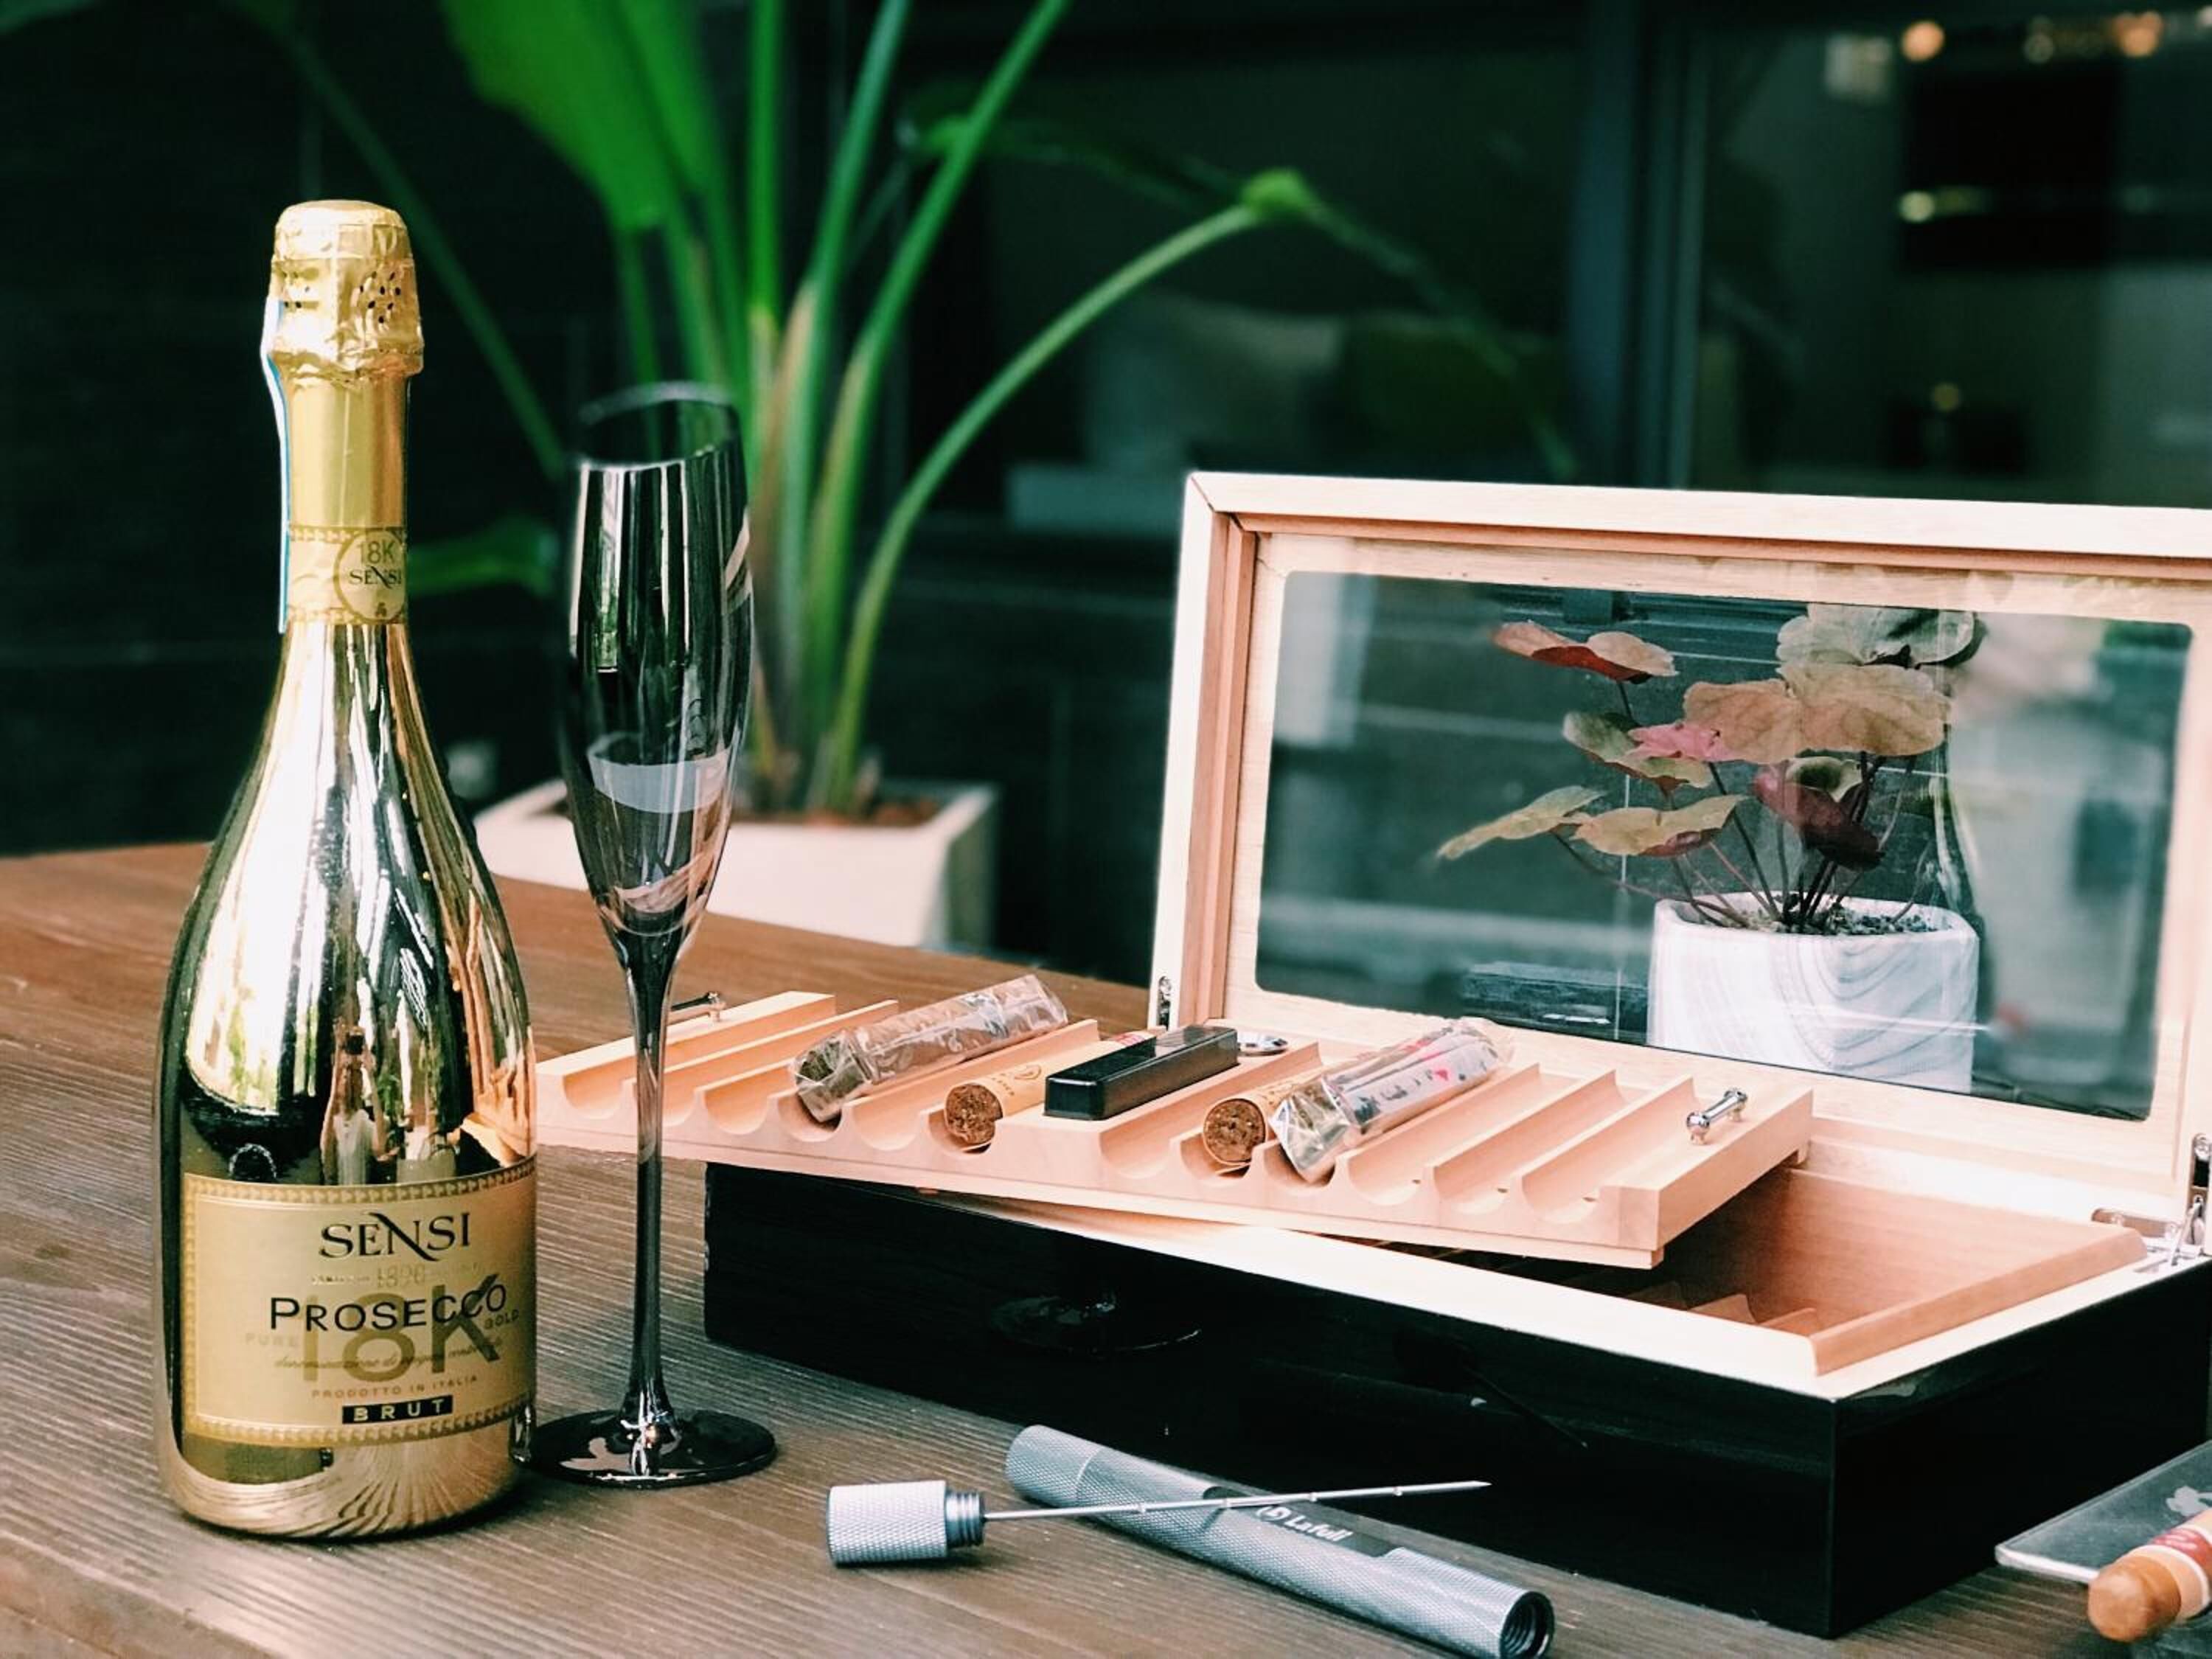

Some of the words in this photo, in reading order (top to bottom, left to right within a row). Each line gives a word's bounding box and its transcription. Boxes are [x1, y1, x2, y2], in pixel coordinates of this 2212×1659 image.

[357, 540, 396, 564] 18K
[349, 566, 402, 589] SENSI
[319, 1211, 470, 1262] SENSI
[302, 1273, 500, 1382] 18K
[312, 1385, 402, 1399] PRODOTTO
[411, 1383, 425, 1393] IN
[432, 1375, 478, 1389] ITALIA
[353, 1399, 445, 1422] BRUT
